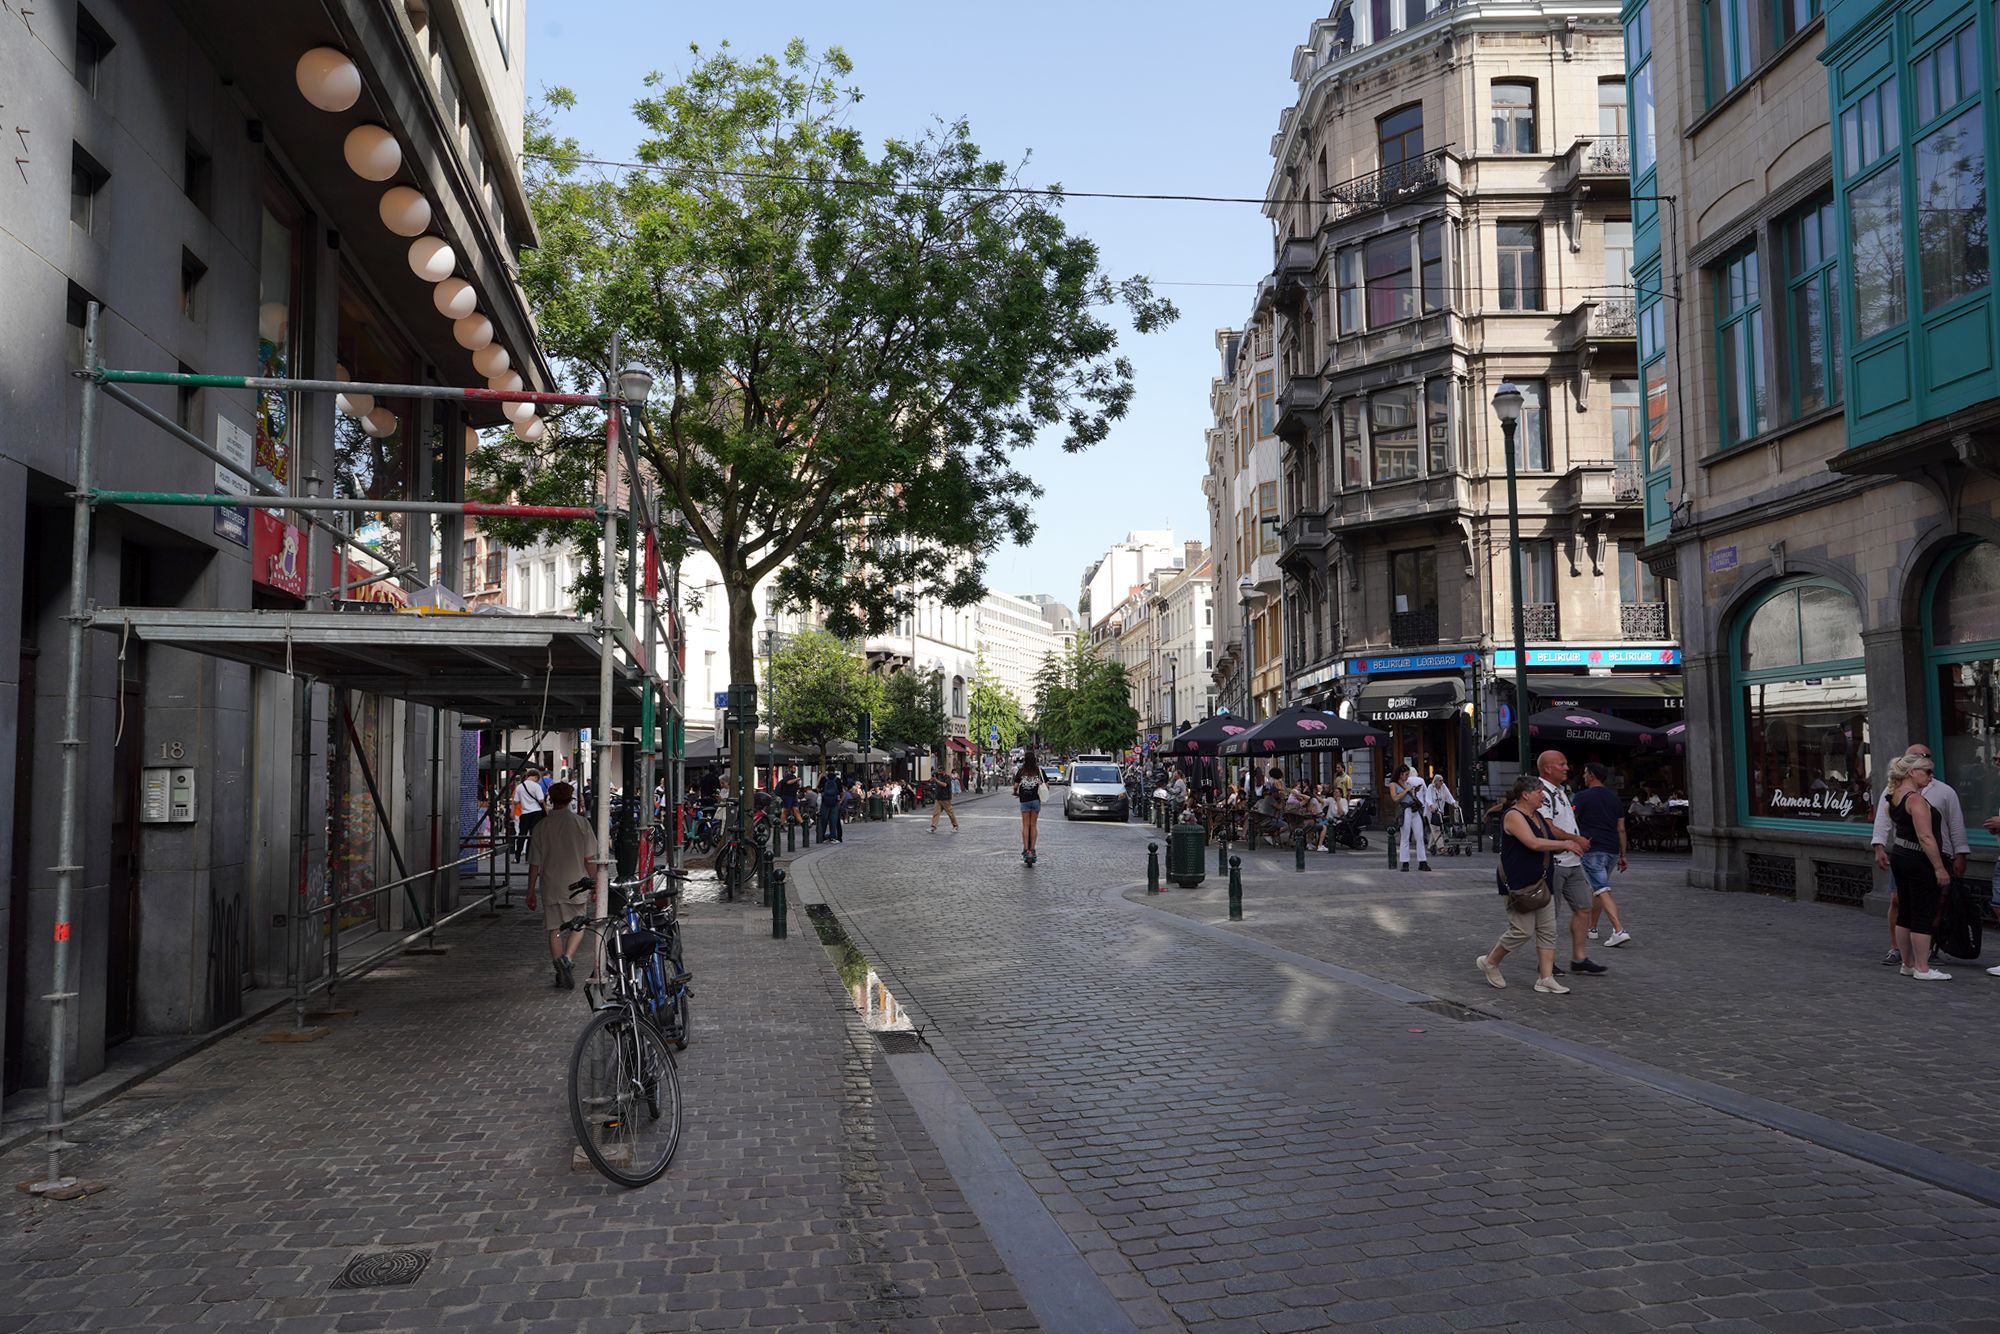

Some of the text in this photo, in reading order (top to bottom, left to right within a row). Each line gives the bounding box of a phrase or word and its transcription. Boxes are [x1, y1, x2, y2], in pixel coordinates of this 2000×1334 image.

[1664, 699, 1676, 708] LE
[1372, 710, 1429, 720] LE LOMBARD
[160, 741, 185, 759] 18
[1771, 788, 1853, 817] Ramon & Valy
